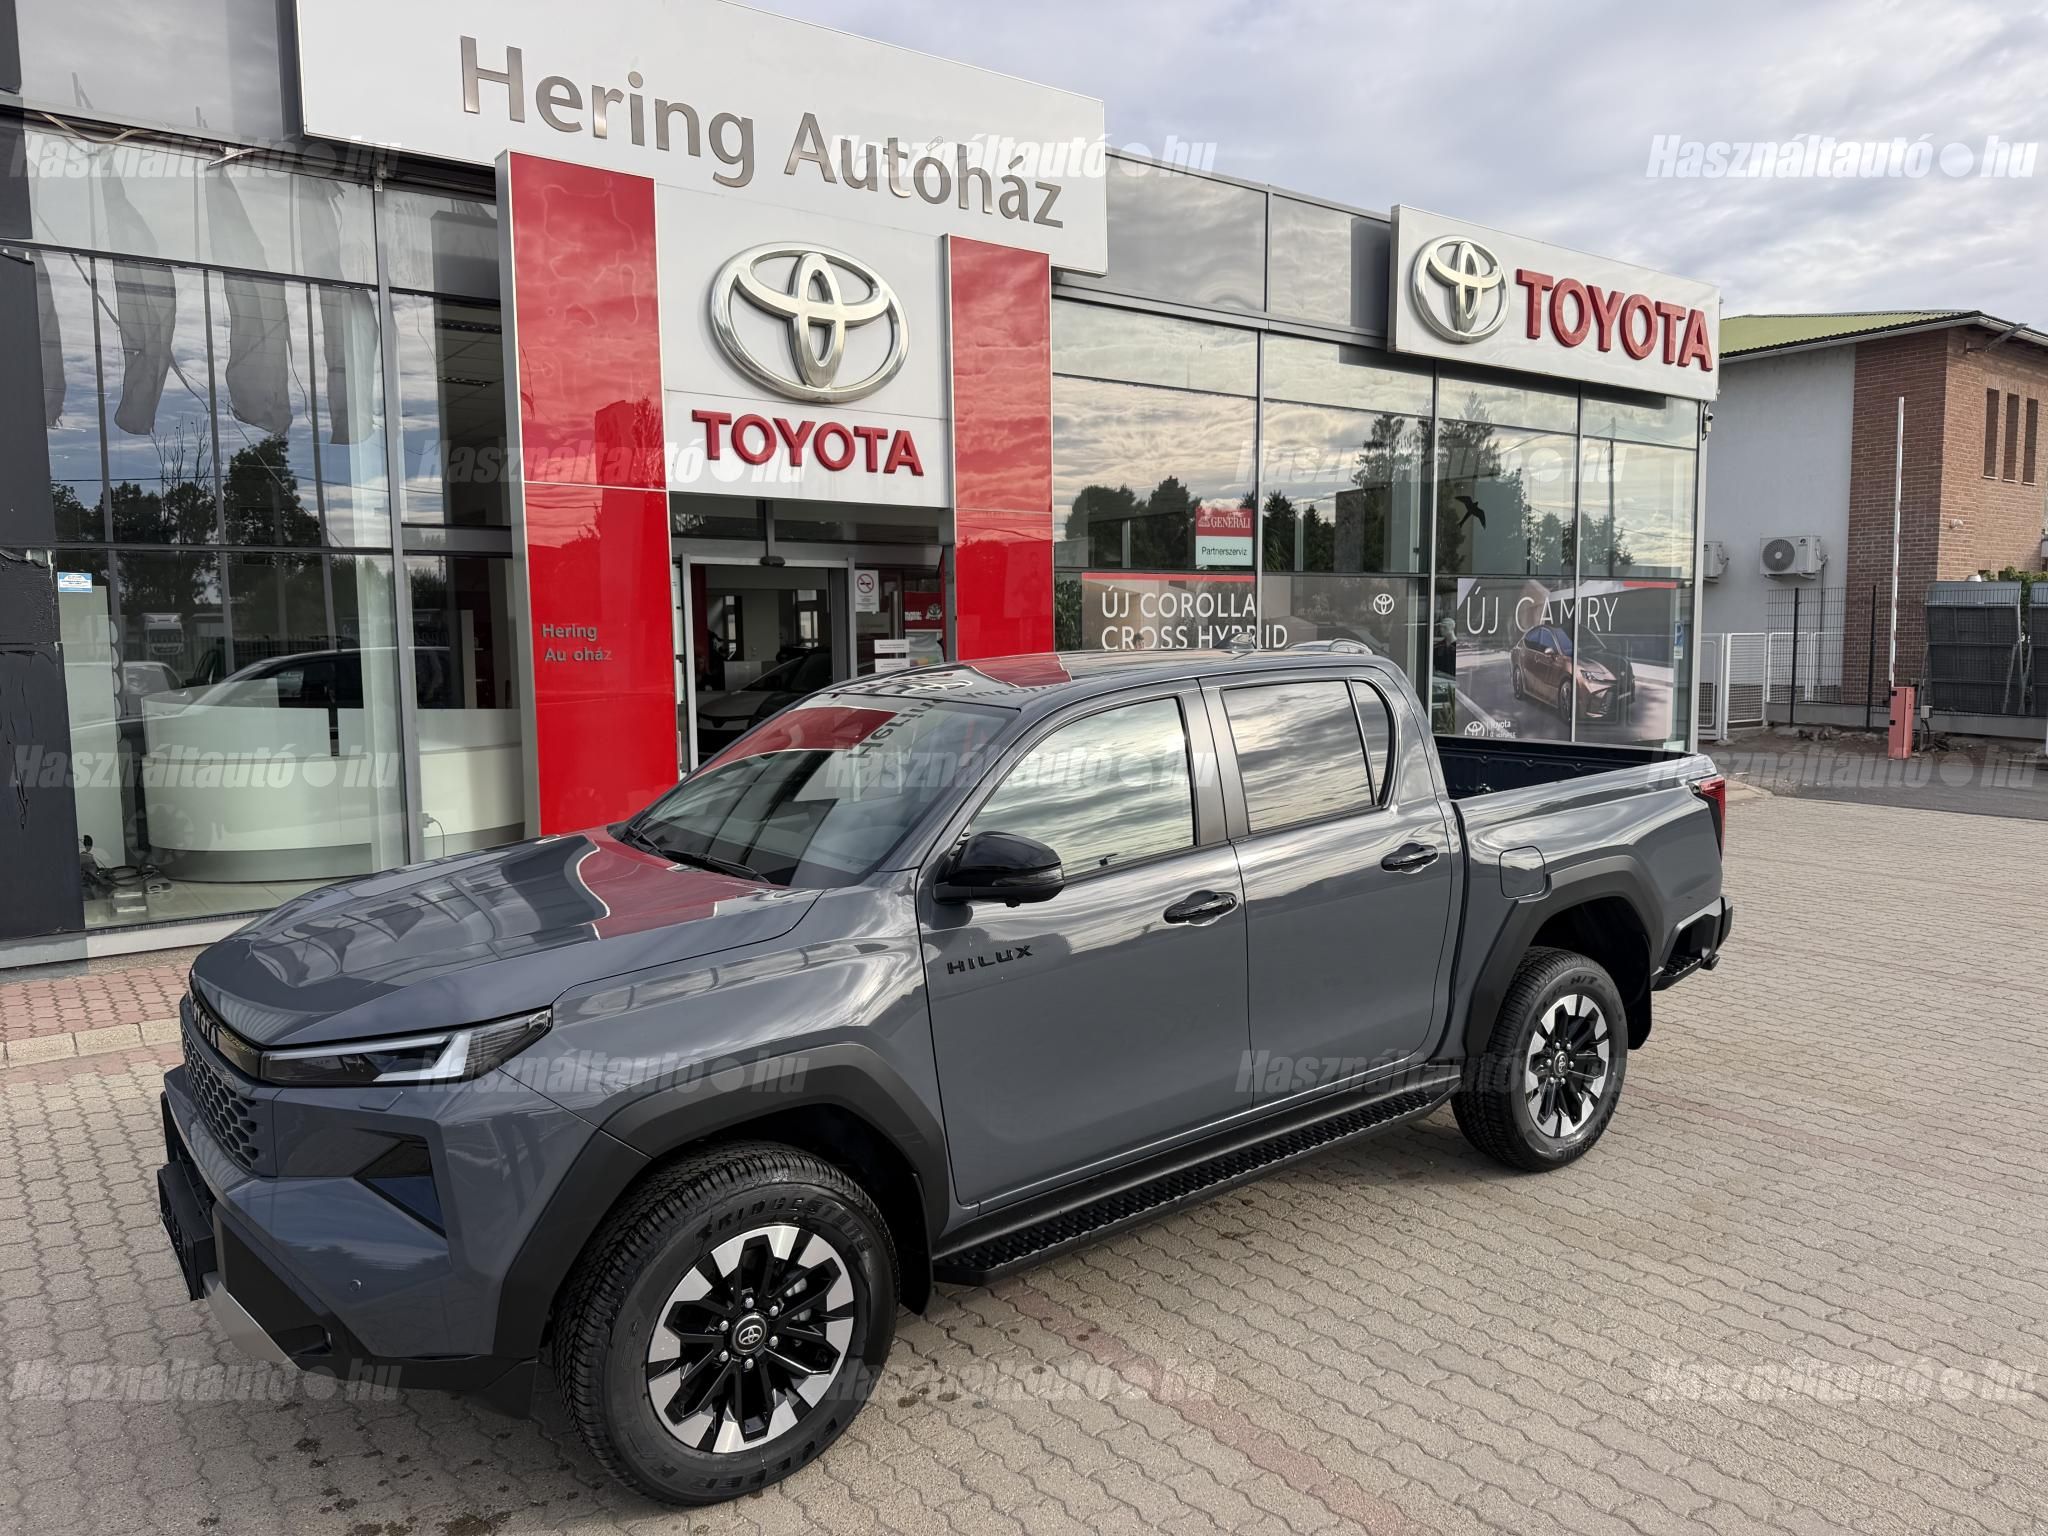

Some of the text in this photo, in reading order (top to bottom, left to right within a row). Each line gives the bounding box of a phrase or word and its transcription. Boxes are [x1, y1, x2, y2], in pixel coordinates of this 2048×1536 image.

[459, 35, 1064, 229] Hering Autóház
[1516, 268, 1714, 372] TOYOTA
[691, 409, 925, 477] TOYOTA
[1210, 516, 1251, 529] GENERALI
[1201, 546, 1248, 556] Partnerszerviz
[1102, 585, 1256, 618] ÚJ COROLLA
[1466, 586, 1619, 635] ÚJ CAMRY
[542, 623, 598, 642] Hering
[1101, 625, 1188, 650] CROSS
[946, 944, 1033, 975] HILUX
